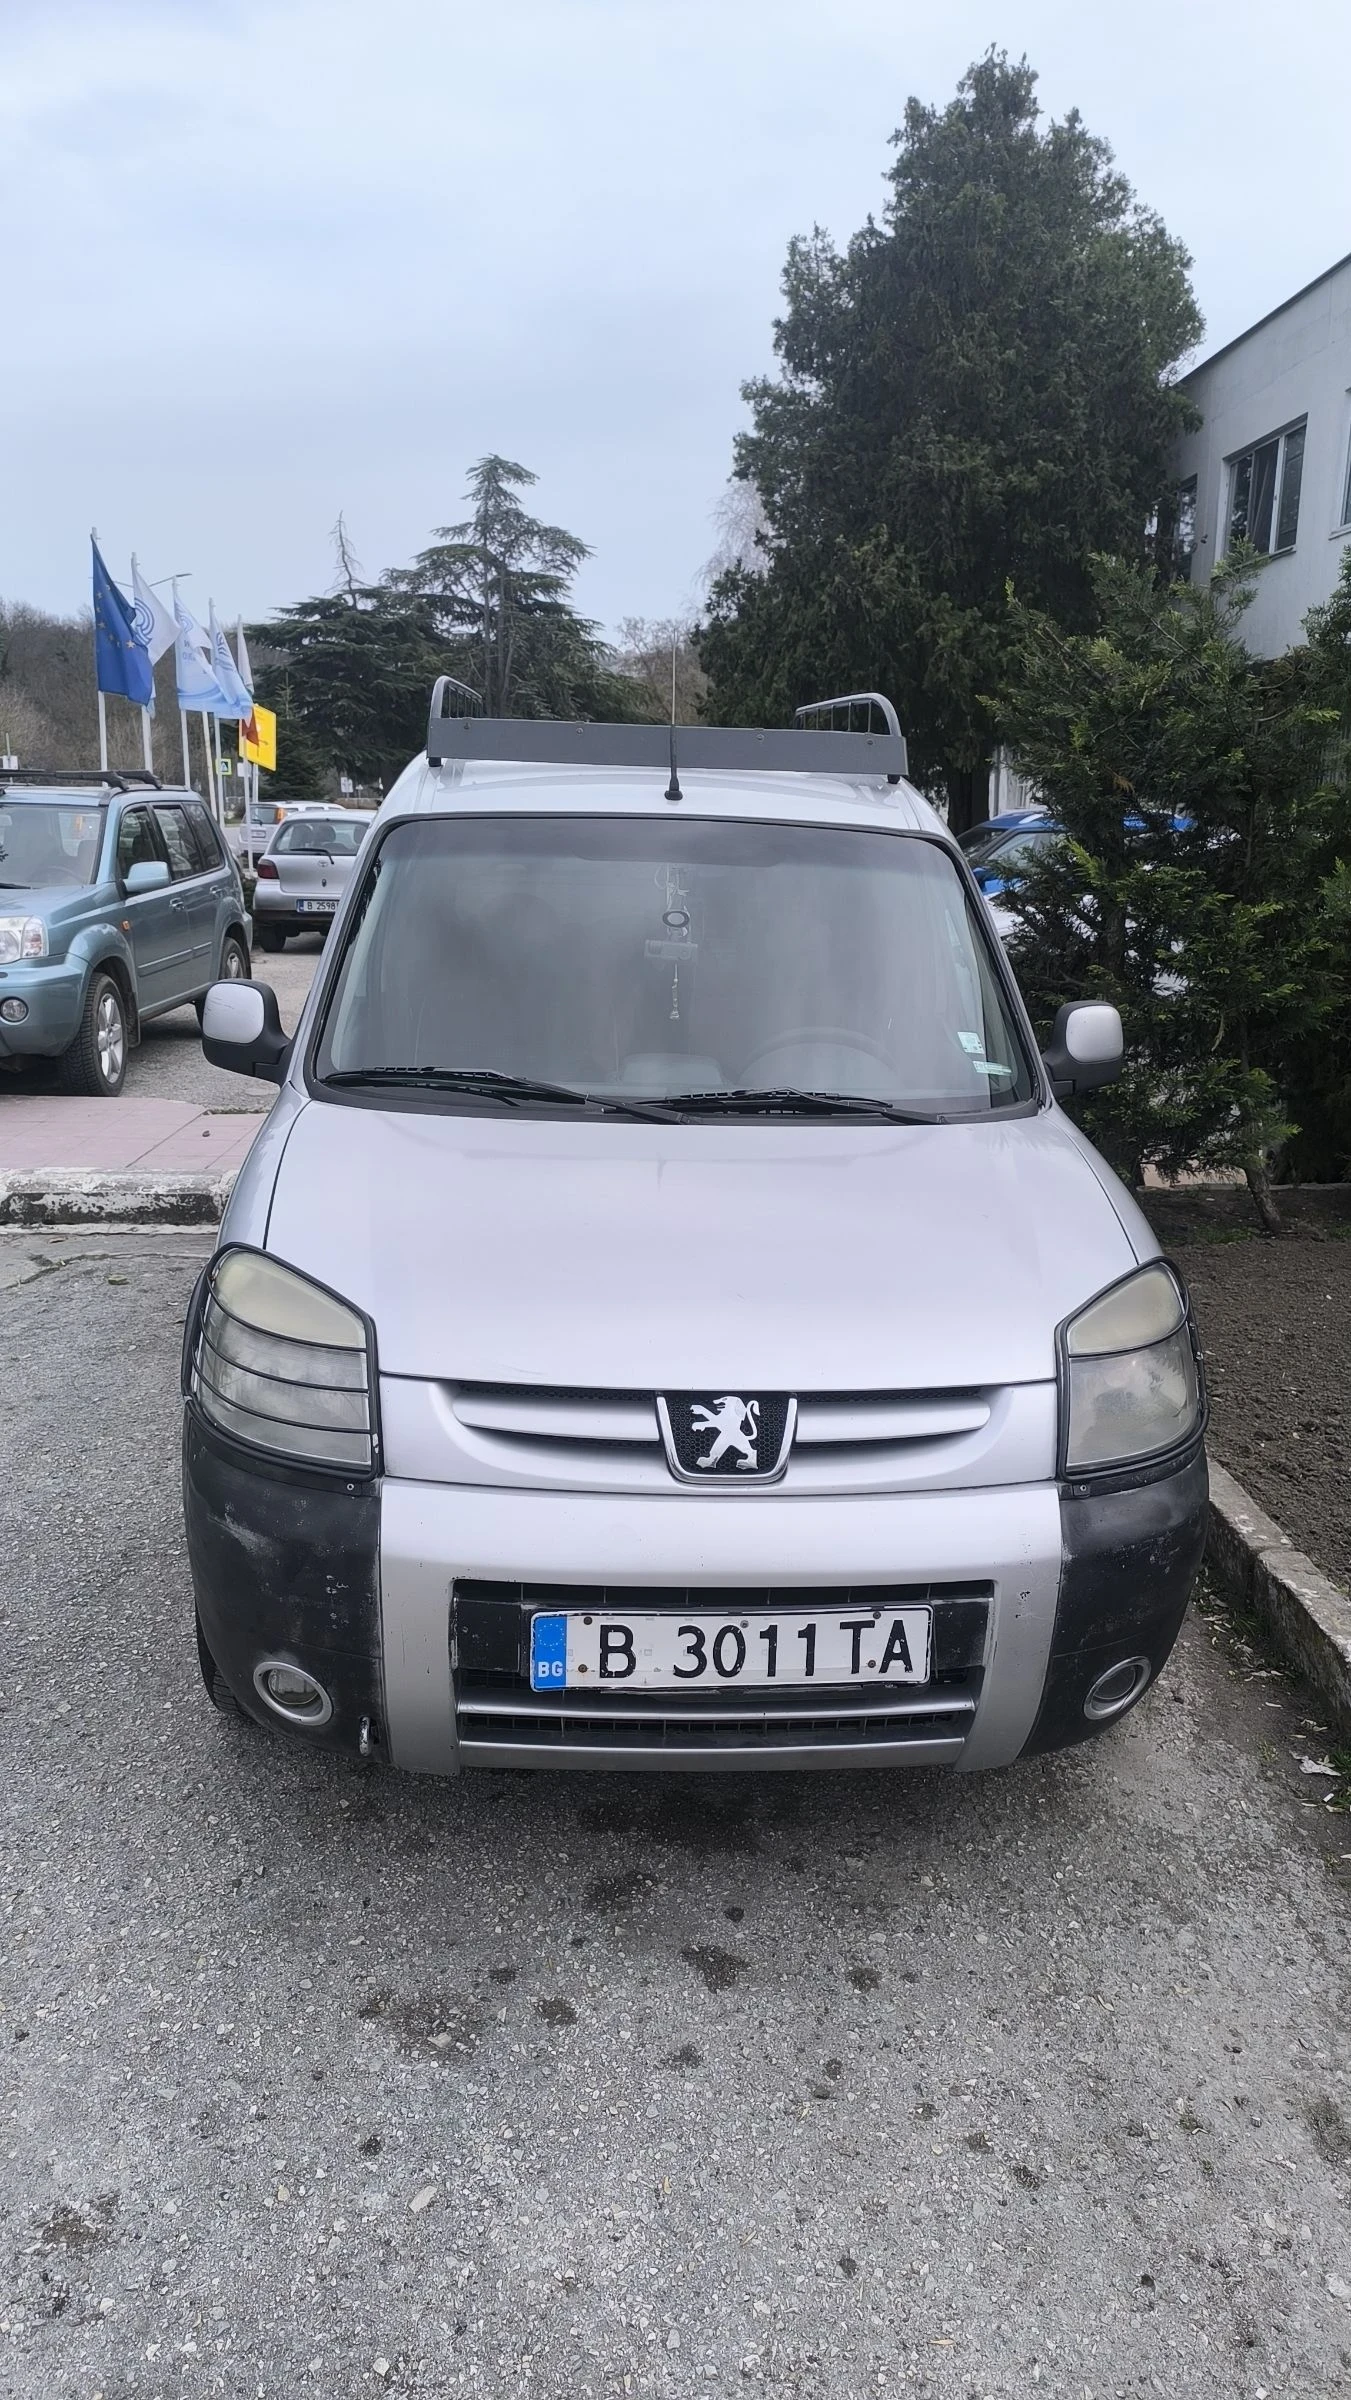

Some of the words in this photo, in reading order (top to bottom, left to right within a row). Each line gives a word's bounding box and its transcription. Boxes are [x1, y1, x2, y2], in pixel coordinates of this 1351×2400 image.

[307, 901, 313, 910] B
[600, 1624, 637, 1678] B
[673, 1623, 817, 1678] 3011
[839, 1619, 913, 1674] TA
[538, 1661, 563, 1678] BG
